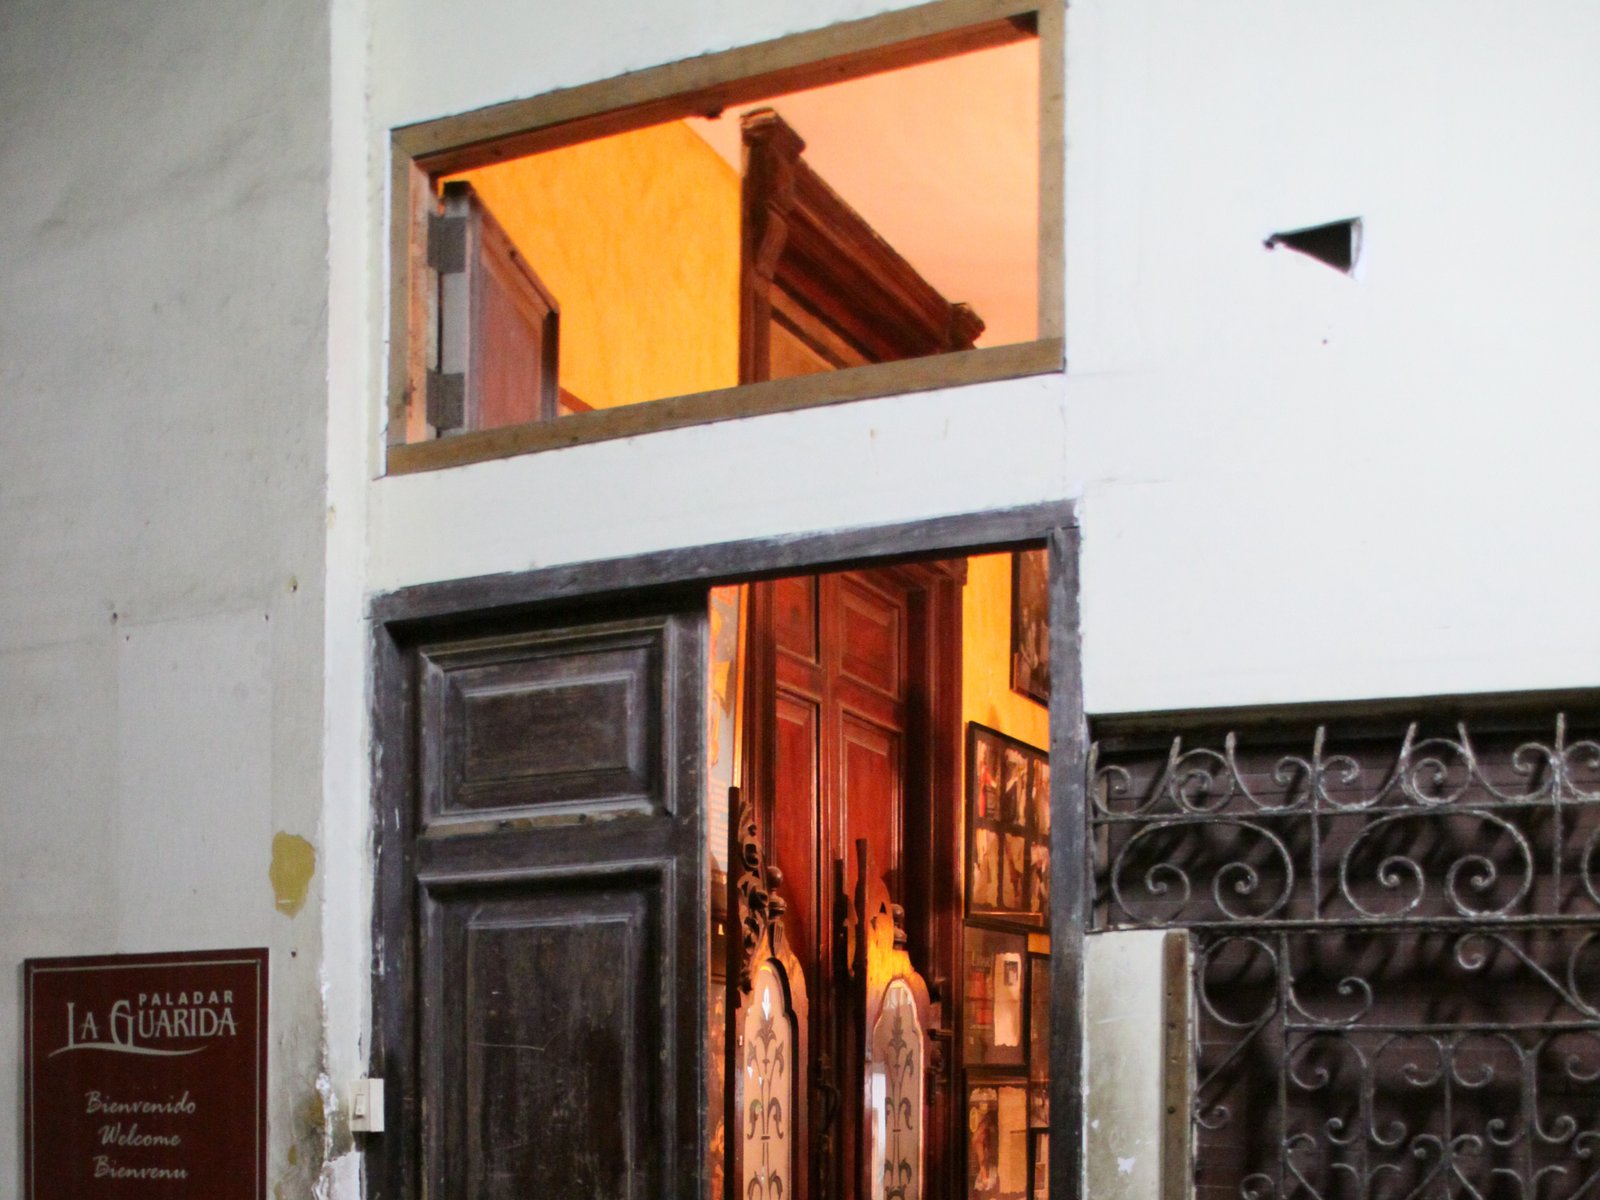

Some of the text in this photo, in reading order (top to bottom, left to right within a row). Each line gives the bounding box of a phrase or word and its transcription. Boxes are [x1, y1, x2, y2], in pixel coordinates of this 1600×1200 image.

[139, 990, 234, 1006] PALADAR
[67, 1000, 239, 1048] LA GUARIDA
[84, 1090, 196, 1114] Bienvenido
[98, 1121, 181, 1146] Welcome
[92, 1154, 188, 1179] Bienvenu
